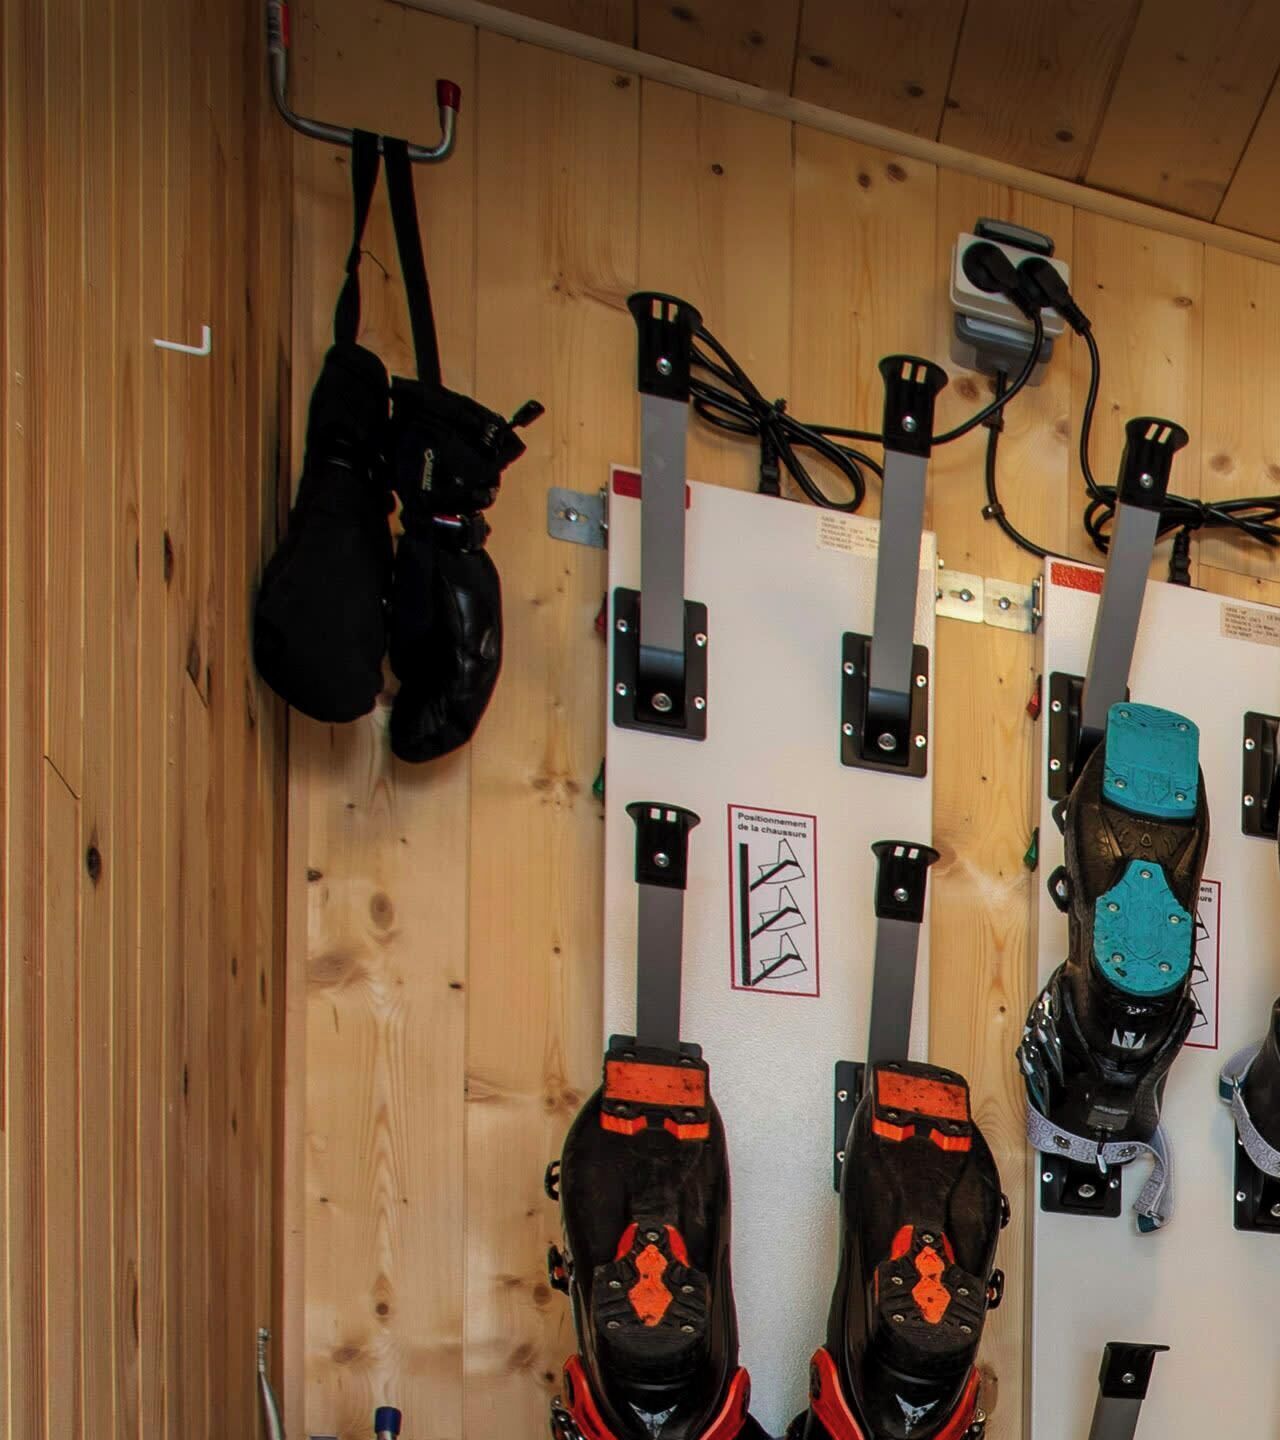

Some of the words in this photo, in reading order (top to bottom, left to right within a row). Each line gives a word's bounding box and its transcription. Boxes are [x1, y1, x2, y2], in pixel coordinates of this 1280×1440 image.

[738, 812, 806, 828] Positionnement
[738, 823, 748, 831] de
[751, 824, 759, 832] la
[761, 826, 806, 838] chaussure
